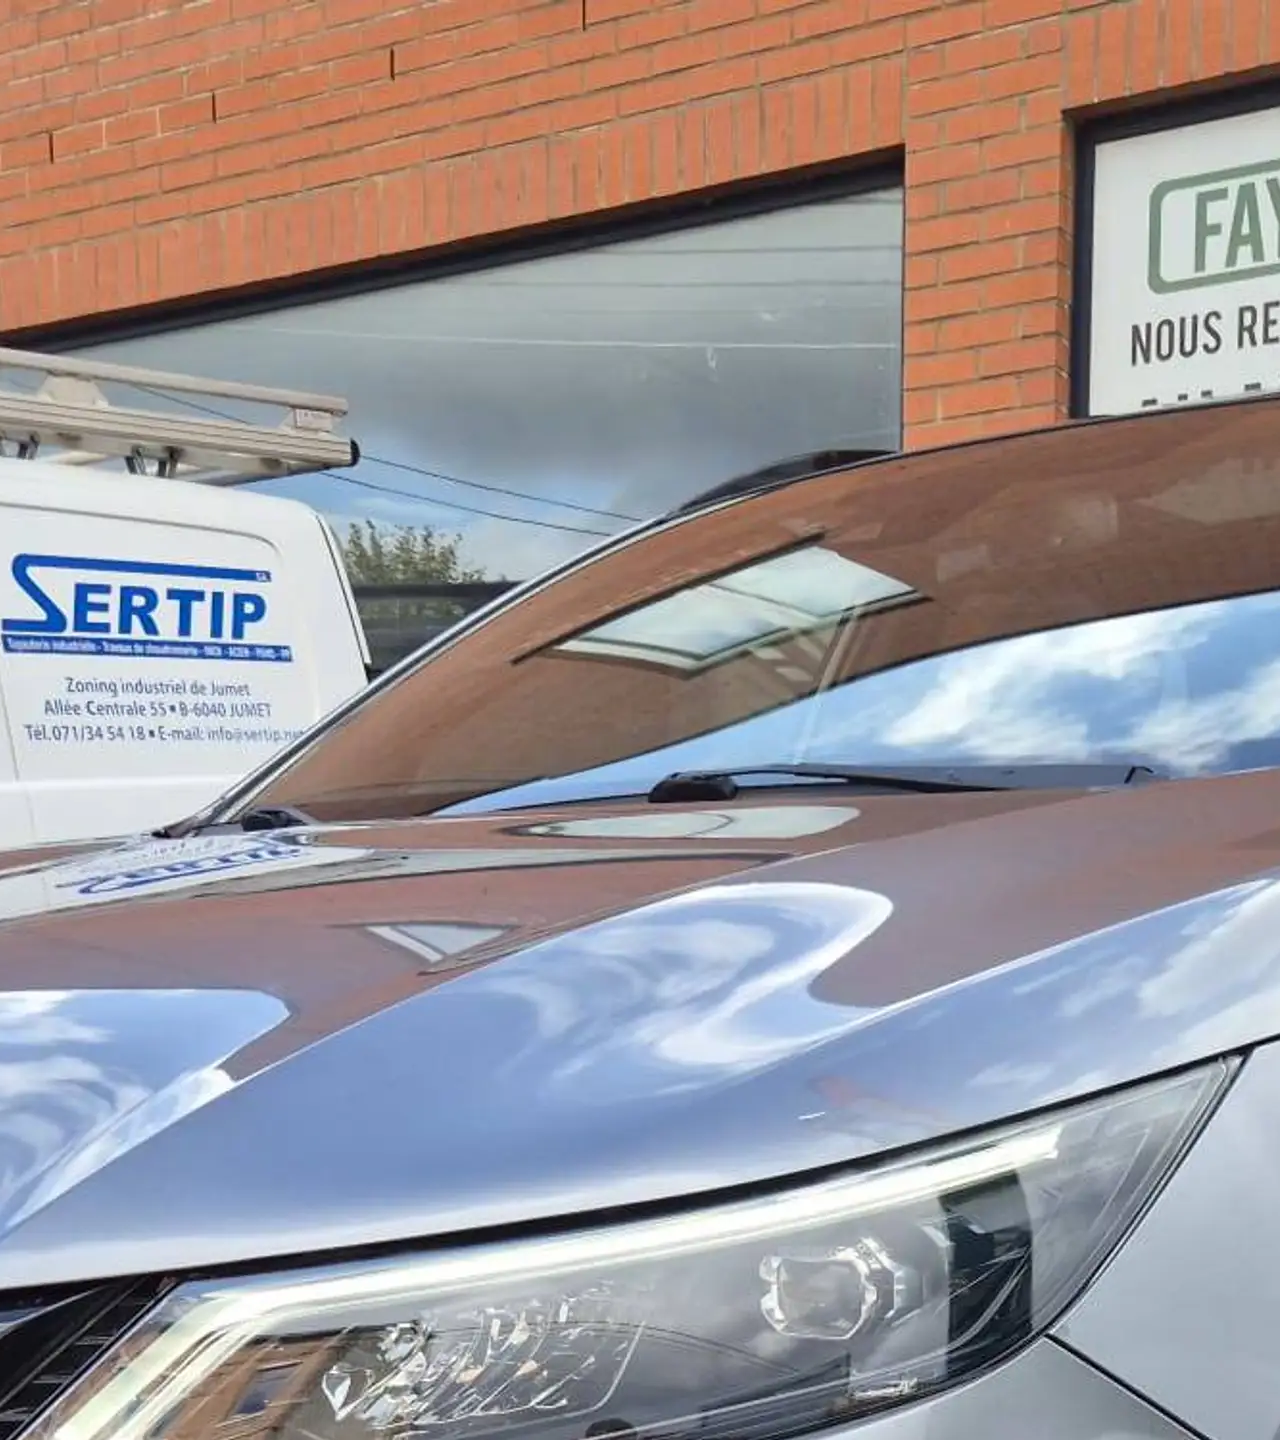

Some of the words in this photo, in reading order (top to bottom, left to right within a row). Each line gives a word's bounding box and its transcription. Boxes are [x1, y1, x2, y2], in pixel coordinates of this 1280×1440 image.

[1131, 311, 1222, 366] NOUS
[1, 553, 272, 639] SERTIP
[66, 677, 118, 697] Zoning
[121, 677, 187, 696] industriel
[190, 680, 207, 695] de
[212, 681, 251, 697] Jumet
[44, 699, 81, 715] Allée
[86, 700, 147, 716] Centrale
[179, 702, 227, 717] B-6040
[229, 703, 272, 718] JUMET
